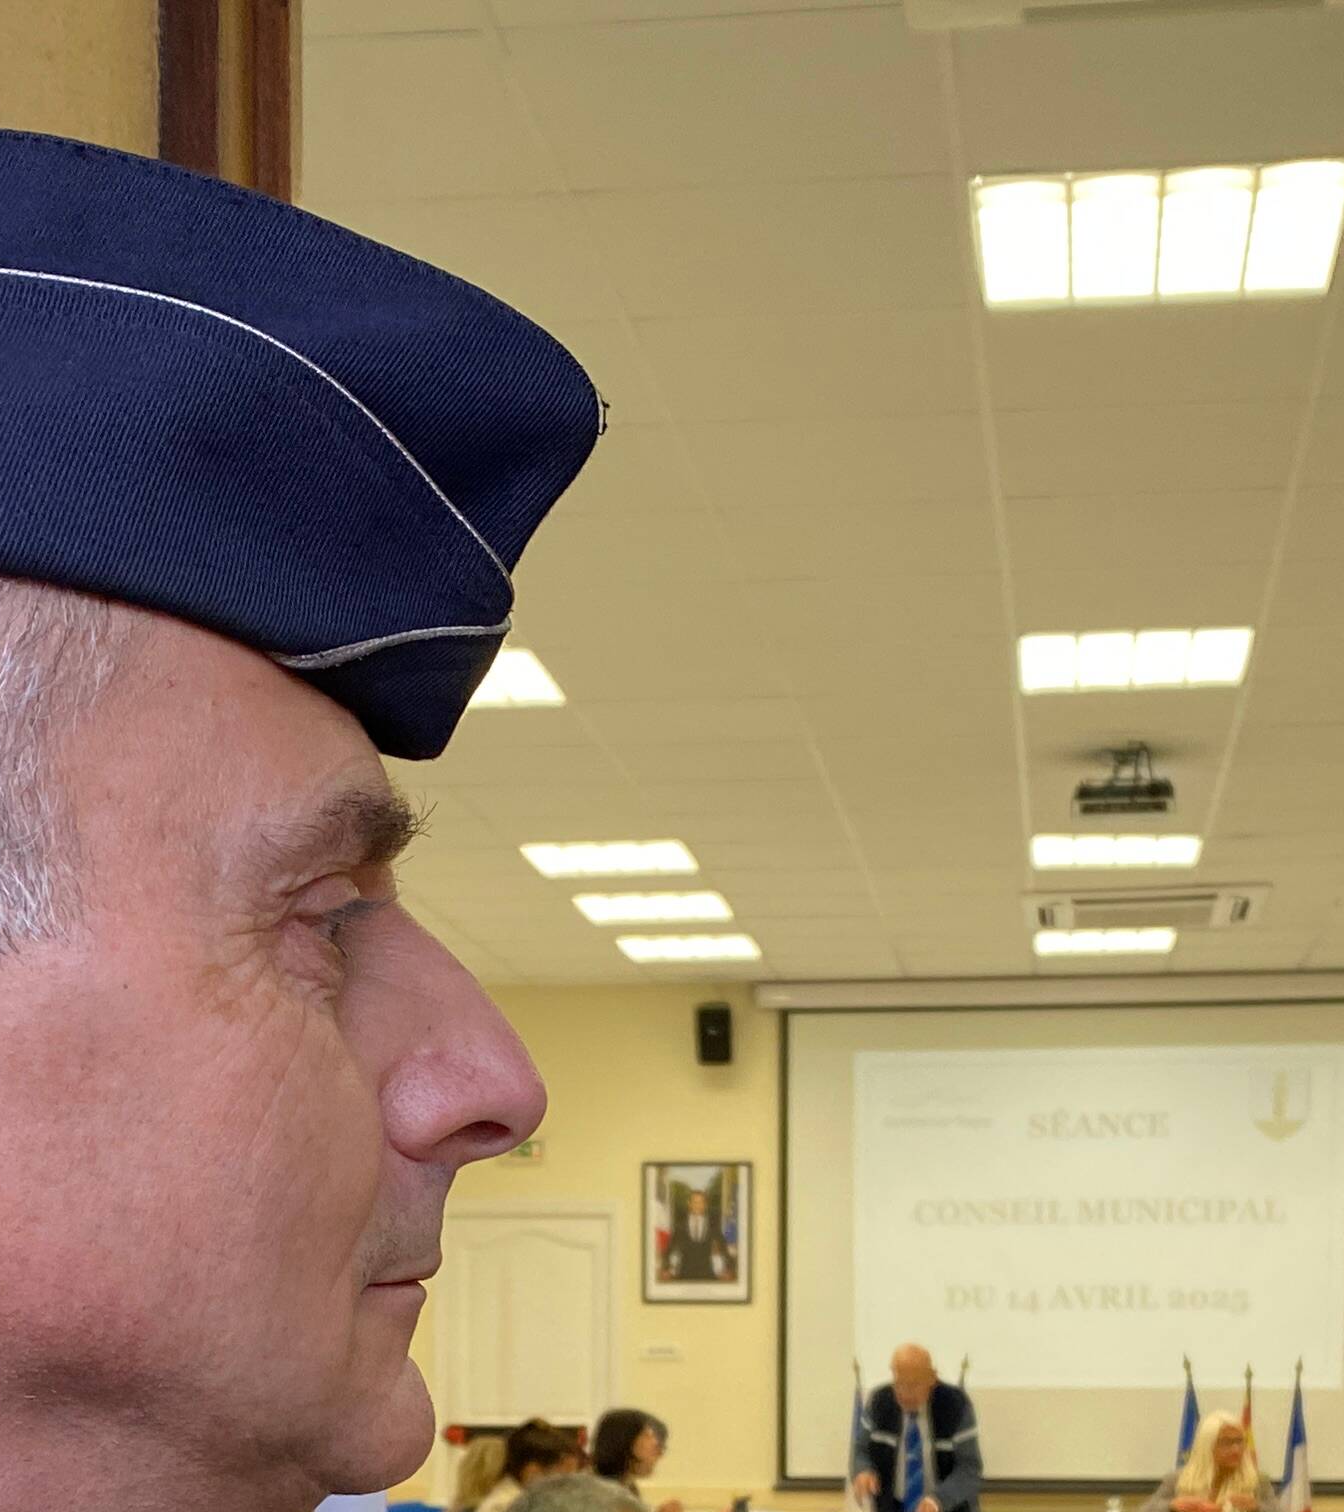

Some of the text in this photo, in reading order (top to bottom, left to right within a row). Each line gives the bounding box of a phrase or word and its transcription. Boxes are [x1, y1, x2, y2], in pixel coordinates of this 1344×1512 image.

[1026, 1107, 1170, 1139] SÉANCE
[911, 1195, 1287, 1226] CONSEIL MUNICIPAL
[945, 1284, 996, 1311] DU
[1006, 1288, 1040, 1314] 14
[1048, 1283, 1159, 1311] AVRIL
